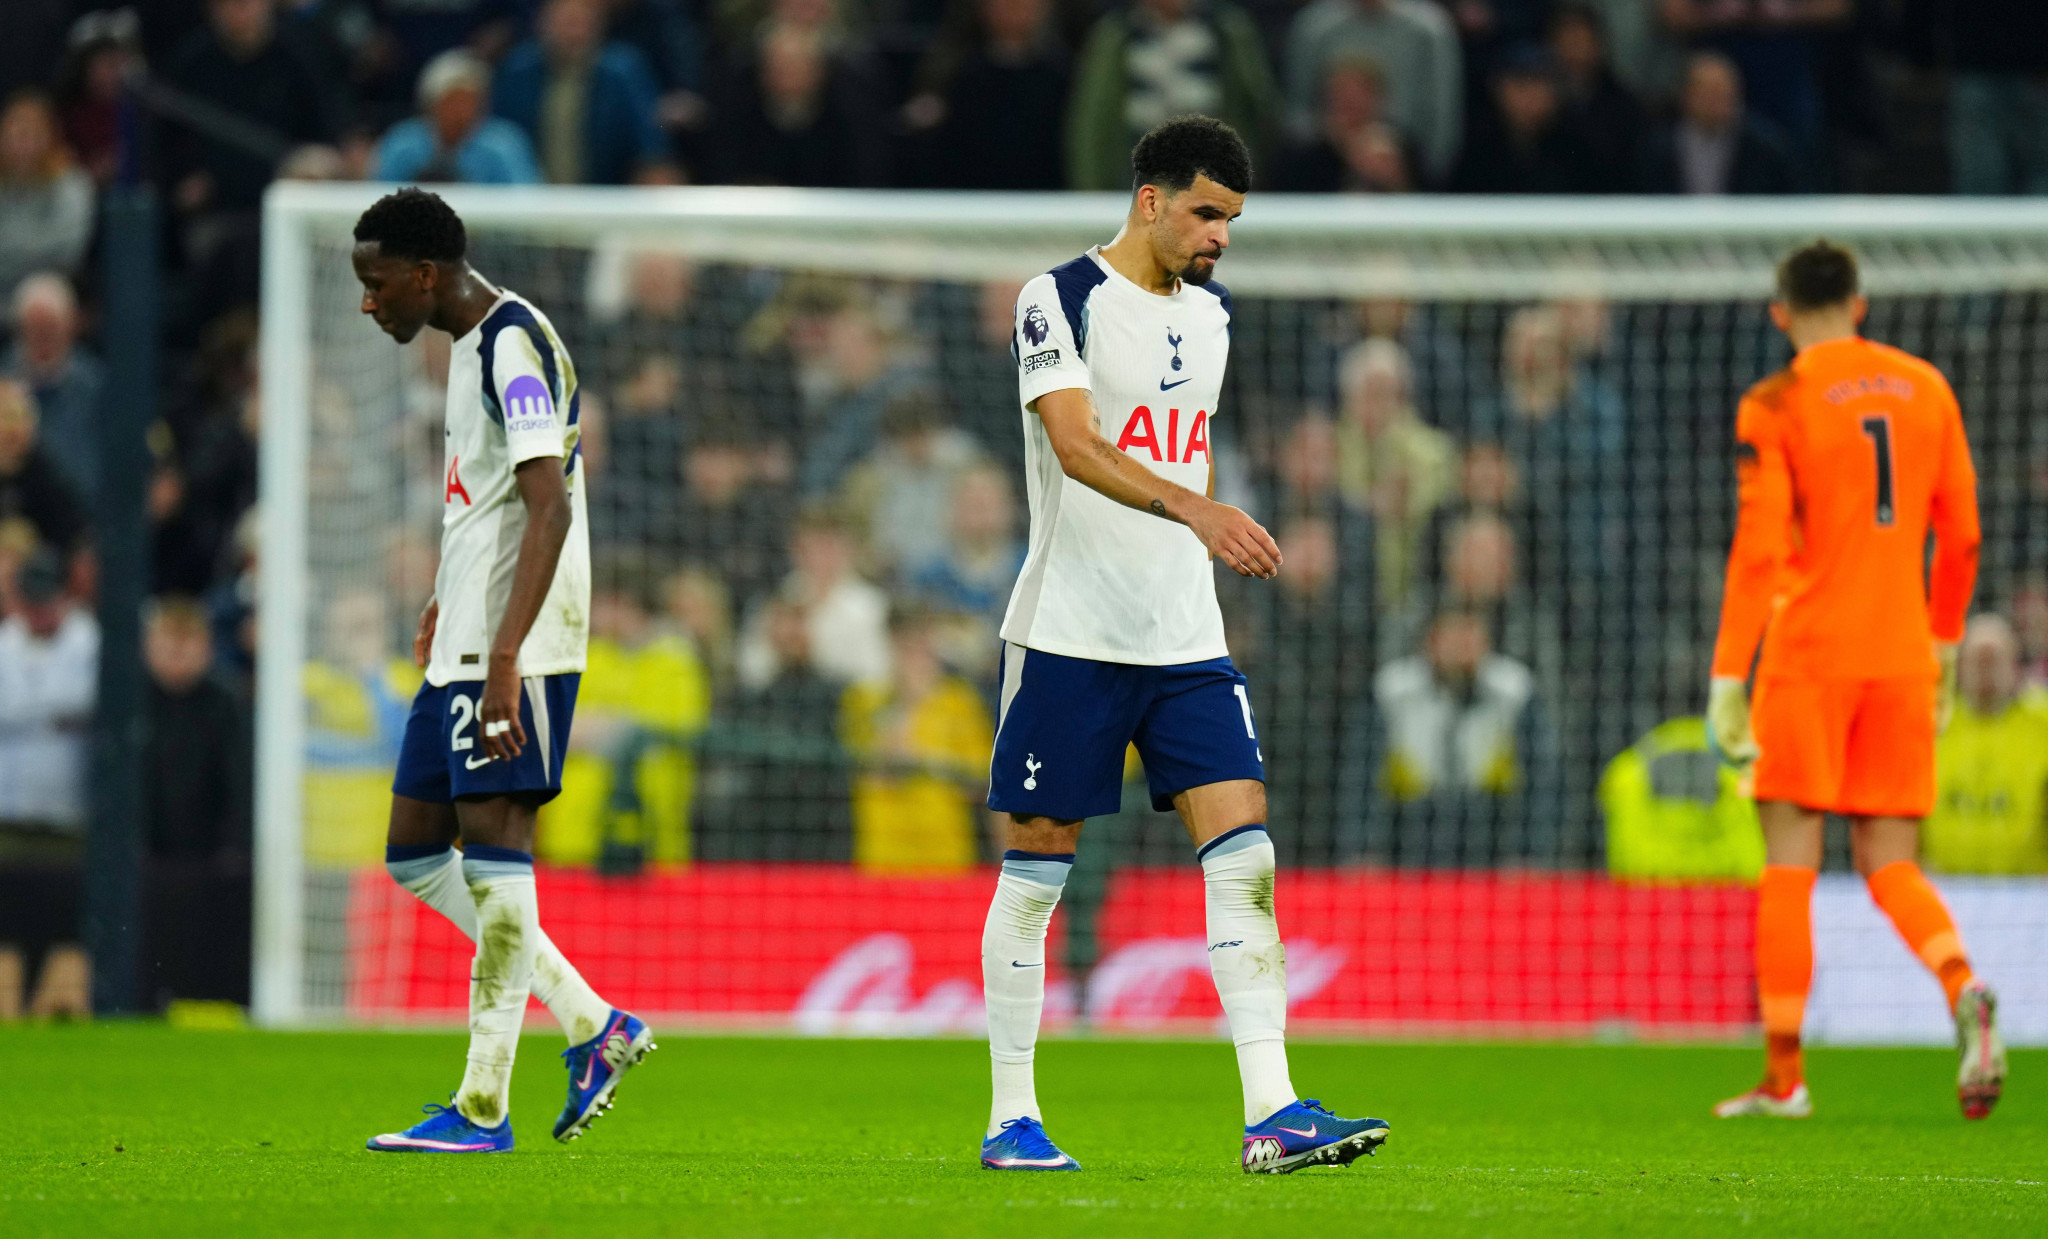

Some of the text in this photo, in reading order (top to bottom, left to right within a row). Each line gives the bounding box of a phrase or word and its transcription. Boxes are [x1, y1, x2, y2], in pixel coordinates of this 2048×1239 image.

[508, 419, 554, 433] kraken
[1116, 405, 1209, 464] AIA
[446, 456, 471, 506] A
[1862, 417, 1894, 525] 1
[1234, 684, 1255, 739] 1
